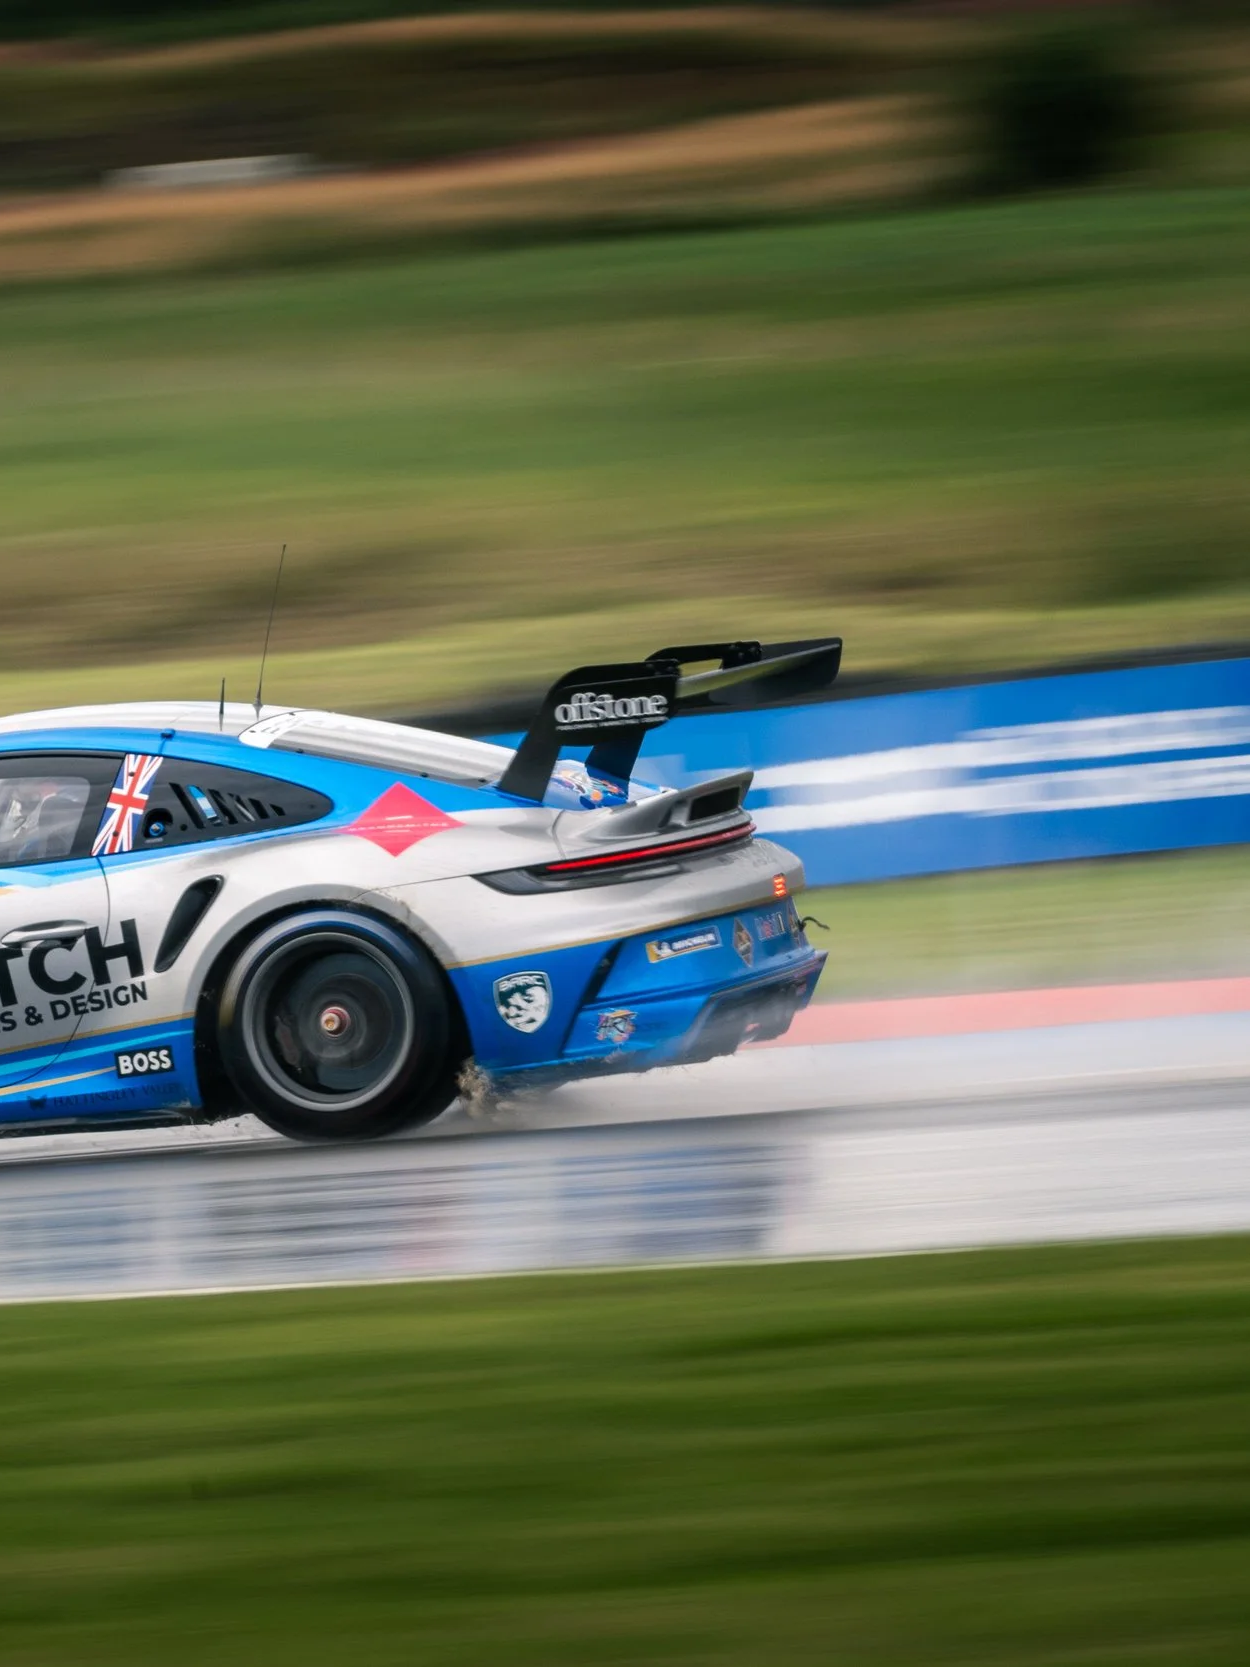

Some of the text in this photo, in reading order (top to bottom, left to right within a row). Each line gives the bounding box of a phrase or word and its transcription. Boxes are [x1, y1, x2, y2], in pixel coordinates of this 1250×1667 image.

[554, 692, 669, 723] offstone
[25, 1006, 44, 1027] &
[50, 981, 148, 1021] DESIGN
[118, 1049, 172, 1074] BOSS
